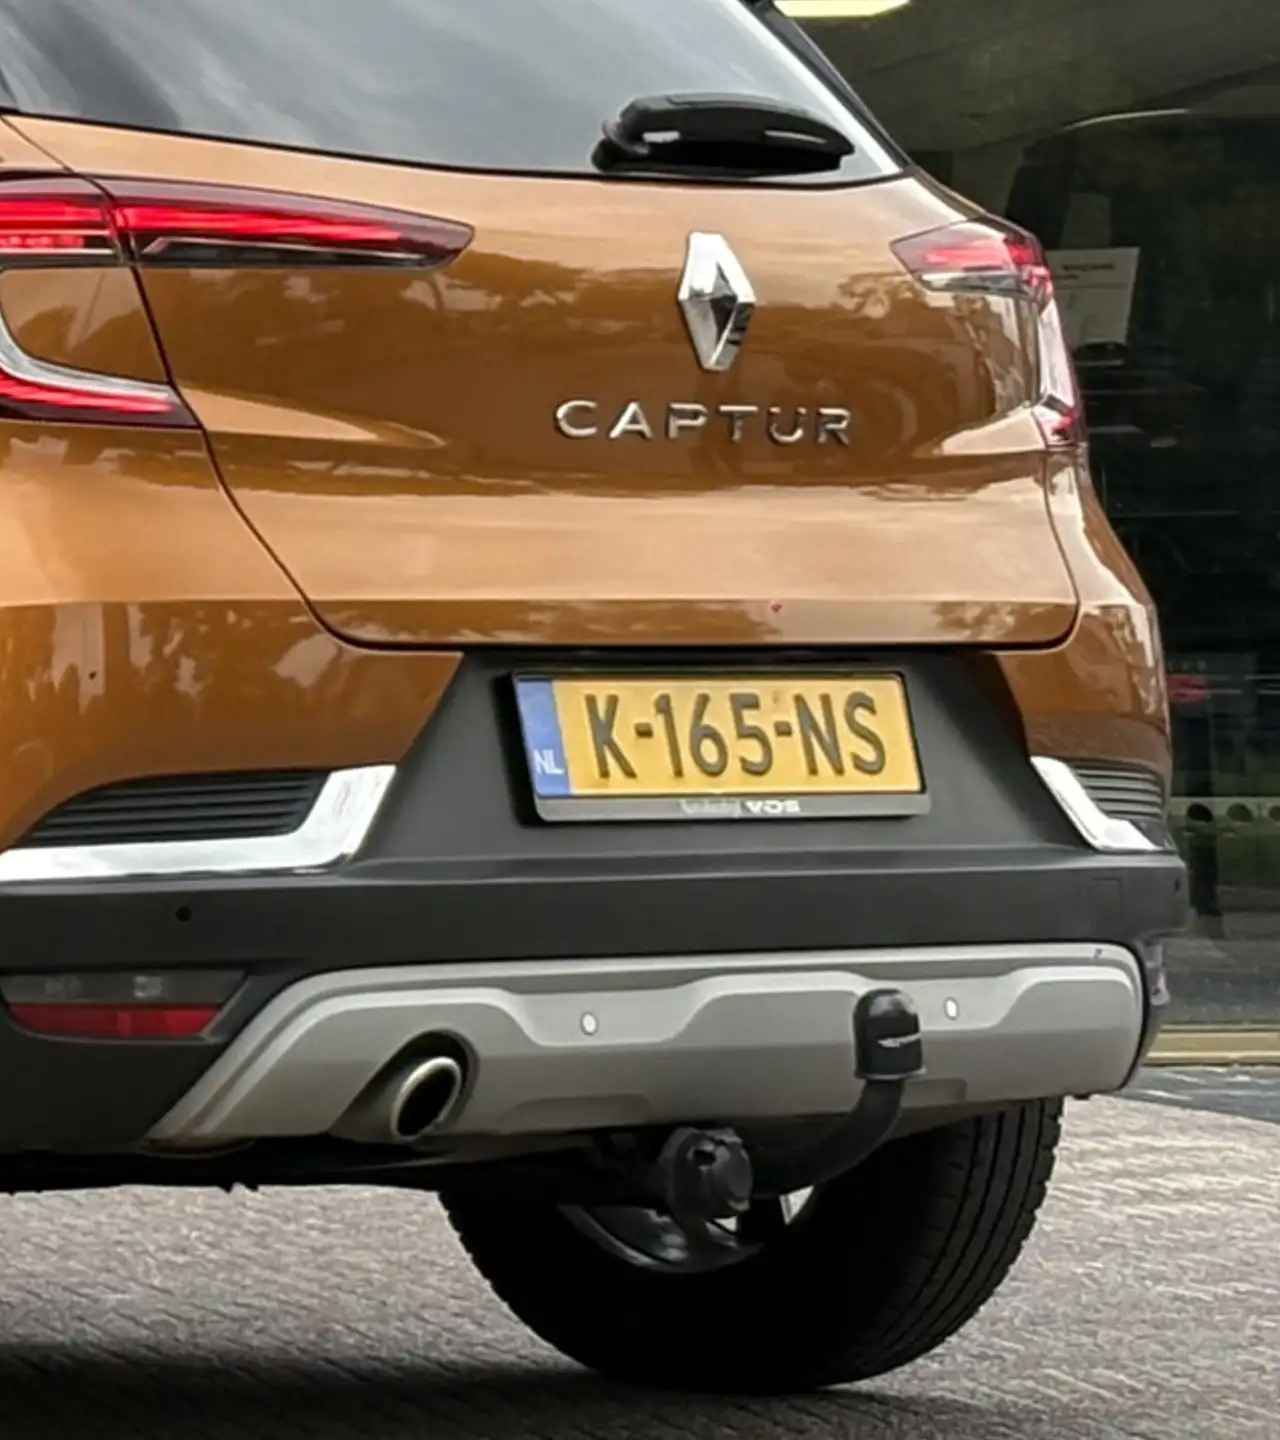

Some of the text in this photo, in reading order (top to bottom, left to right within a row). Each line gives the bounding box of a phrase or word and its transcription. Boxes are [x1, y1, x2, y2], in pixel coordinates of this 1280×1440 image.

[554, 398, 853, 446] CAPTUR
[584, 690, 887, 779] K-165-NS
[532, 748, 566, 776] NL
